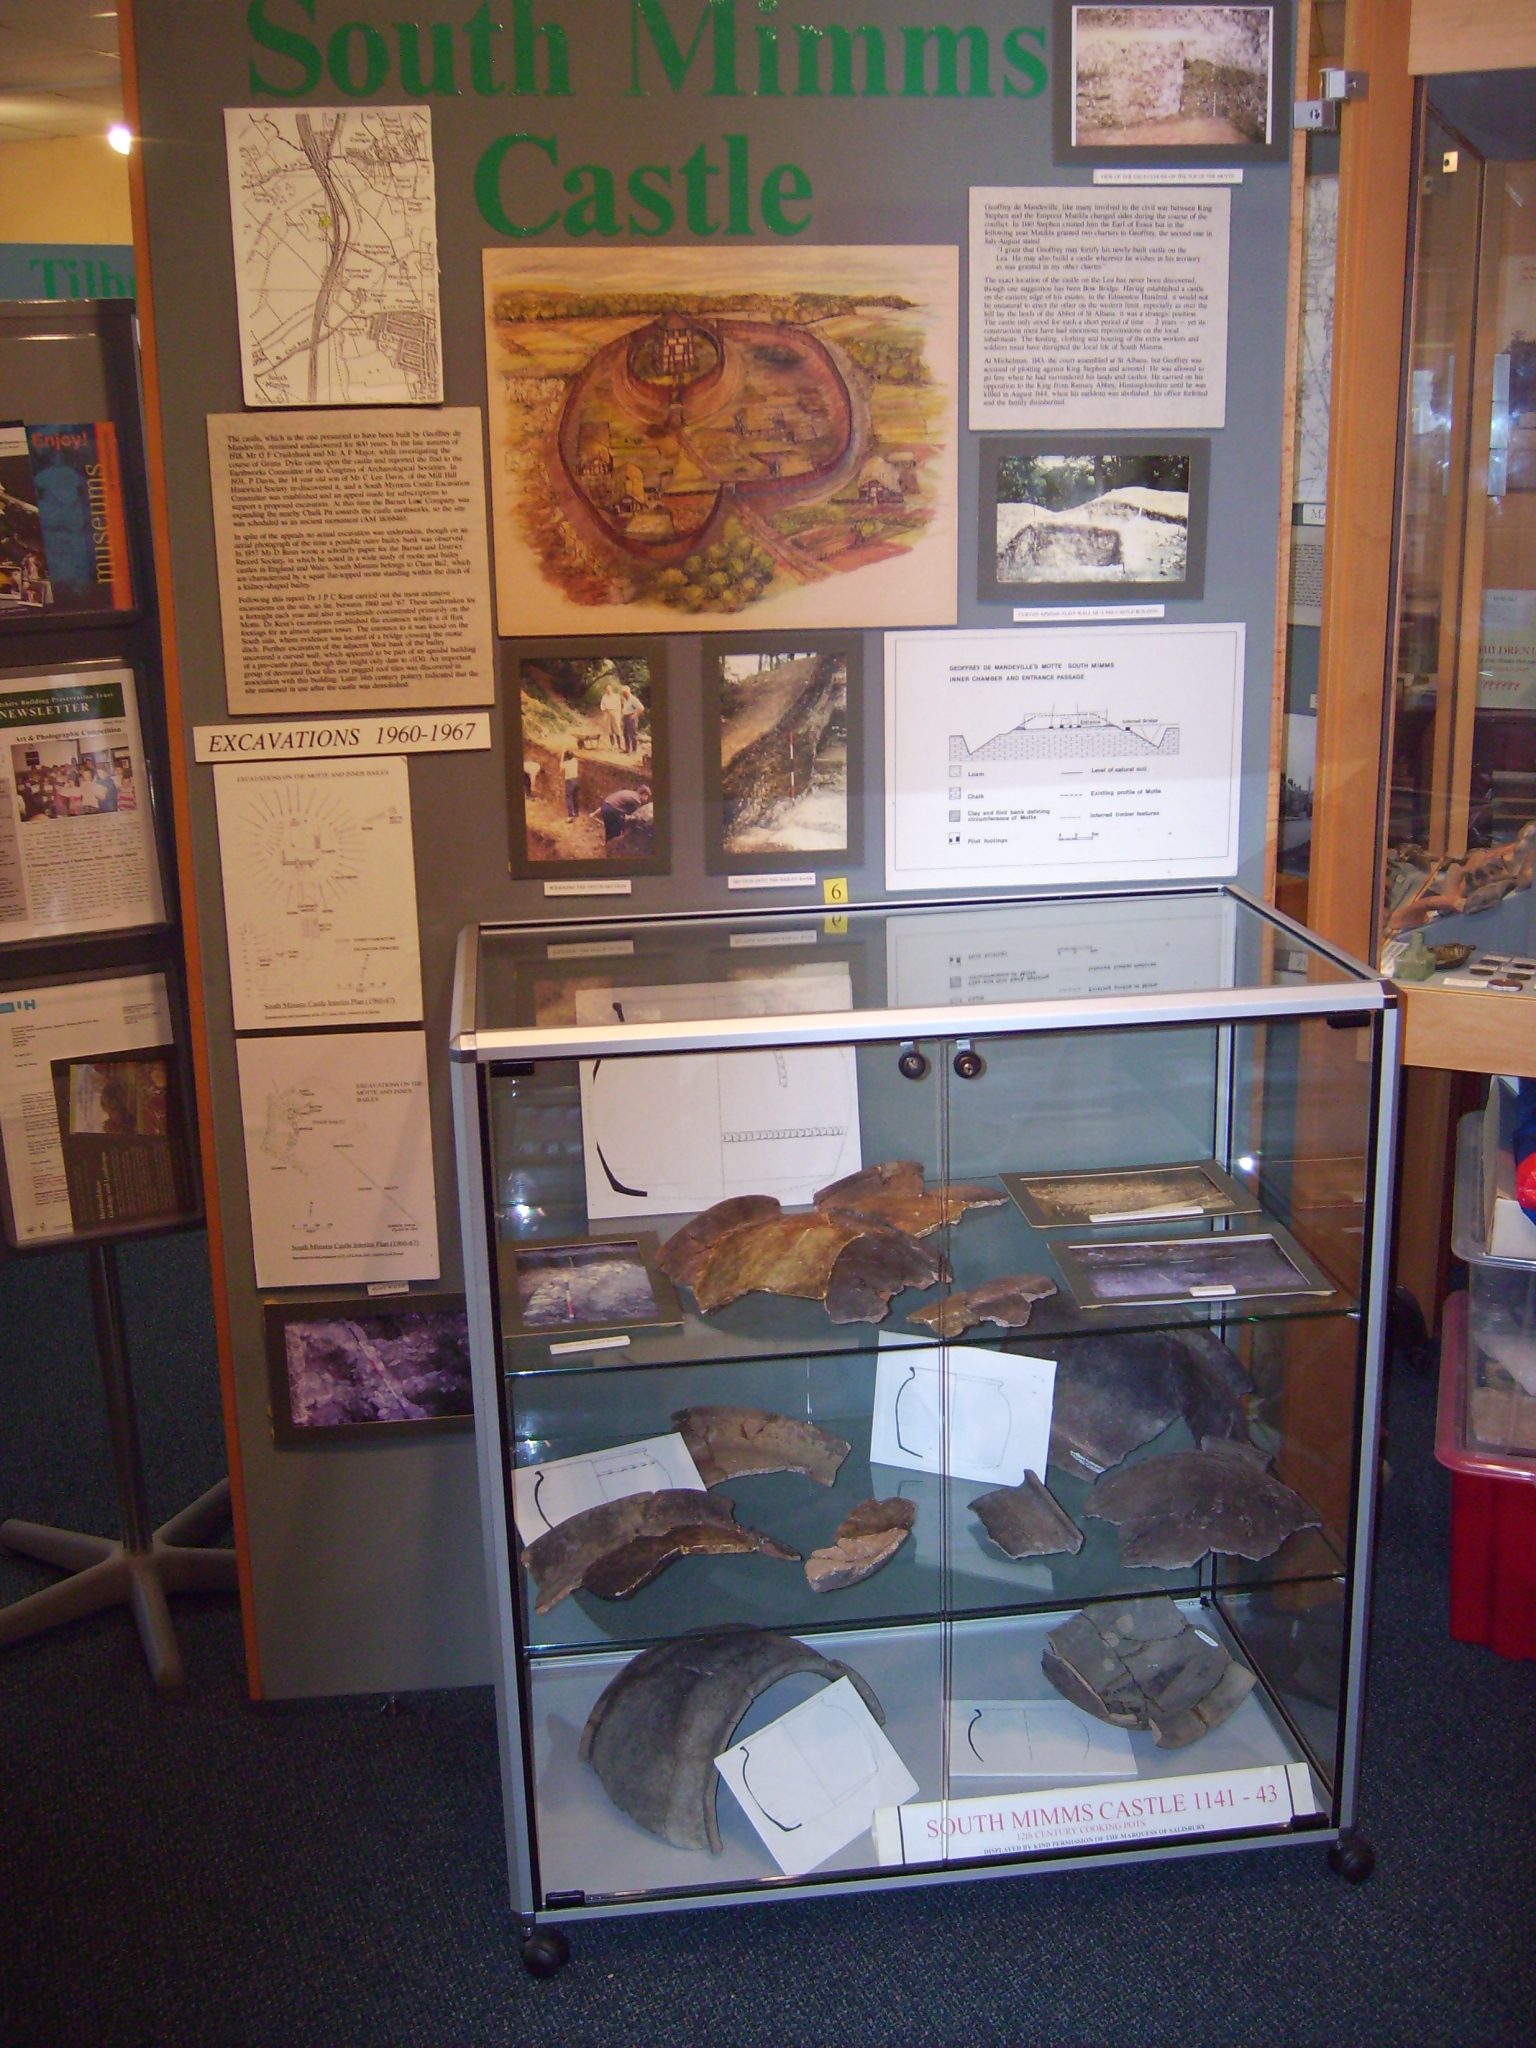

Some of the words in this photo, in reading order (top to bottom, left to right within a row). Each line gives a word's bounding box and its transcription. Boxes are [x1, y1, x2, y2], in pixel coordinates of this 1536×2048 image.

[248, 0, 575, 98] South
[623, 0, 1049, 98] Mimms
[473, 132, 813, 238] Castle
[31, 432, 88, 450] Enjoy!
[85, 464, 115, 584] museums
[1479, 645, 1536, 655] HILDREN!
[0, 702, 90, 719] NEWSLETTER
[209, 728, 360, 753] EXCAVATIONS
[376, 722, 476, 745] 1960-1967
[831, 882, 842, 900] 6
[926, 1812, 1004, 1838] SOUTH
[1011, 1802, 1094, 1830] MIMMS
[1099, 1793, 1186, 1820] CASTLE
[1194, 1788, 1234, 1810] 1141
[1256, 1784, 1278, 1804] 43
[1017, 1832, 1033, 1841] 12th
[1034, 1828, 1076, 1839] CENTURY
[1079, 1822, 1122, 1834] COOKING
[1124, 1820, 1146, 1830] POTS
[1034, 1841, 1051, 1849] KIND
[1052, 1836, 1094, 1848] PERMISSION
[1120, 1830, 1158, 1840] MARQUESS
[1169, 1824, 1206, 1834] SALISBURY
